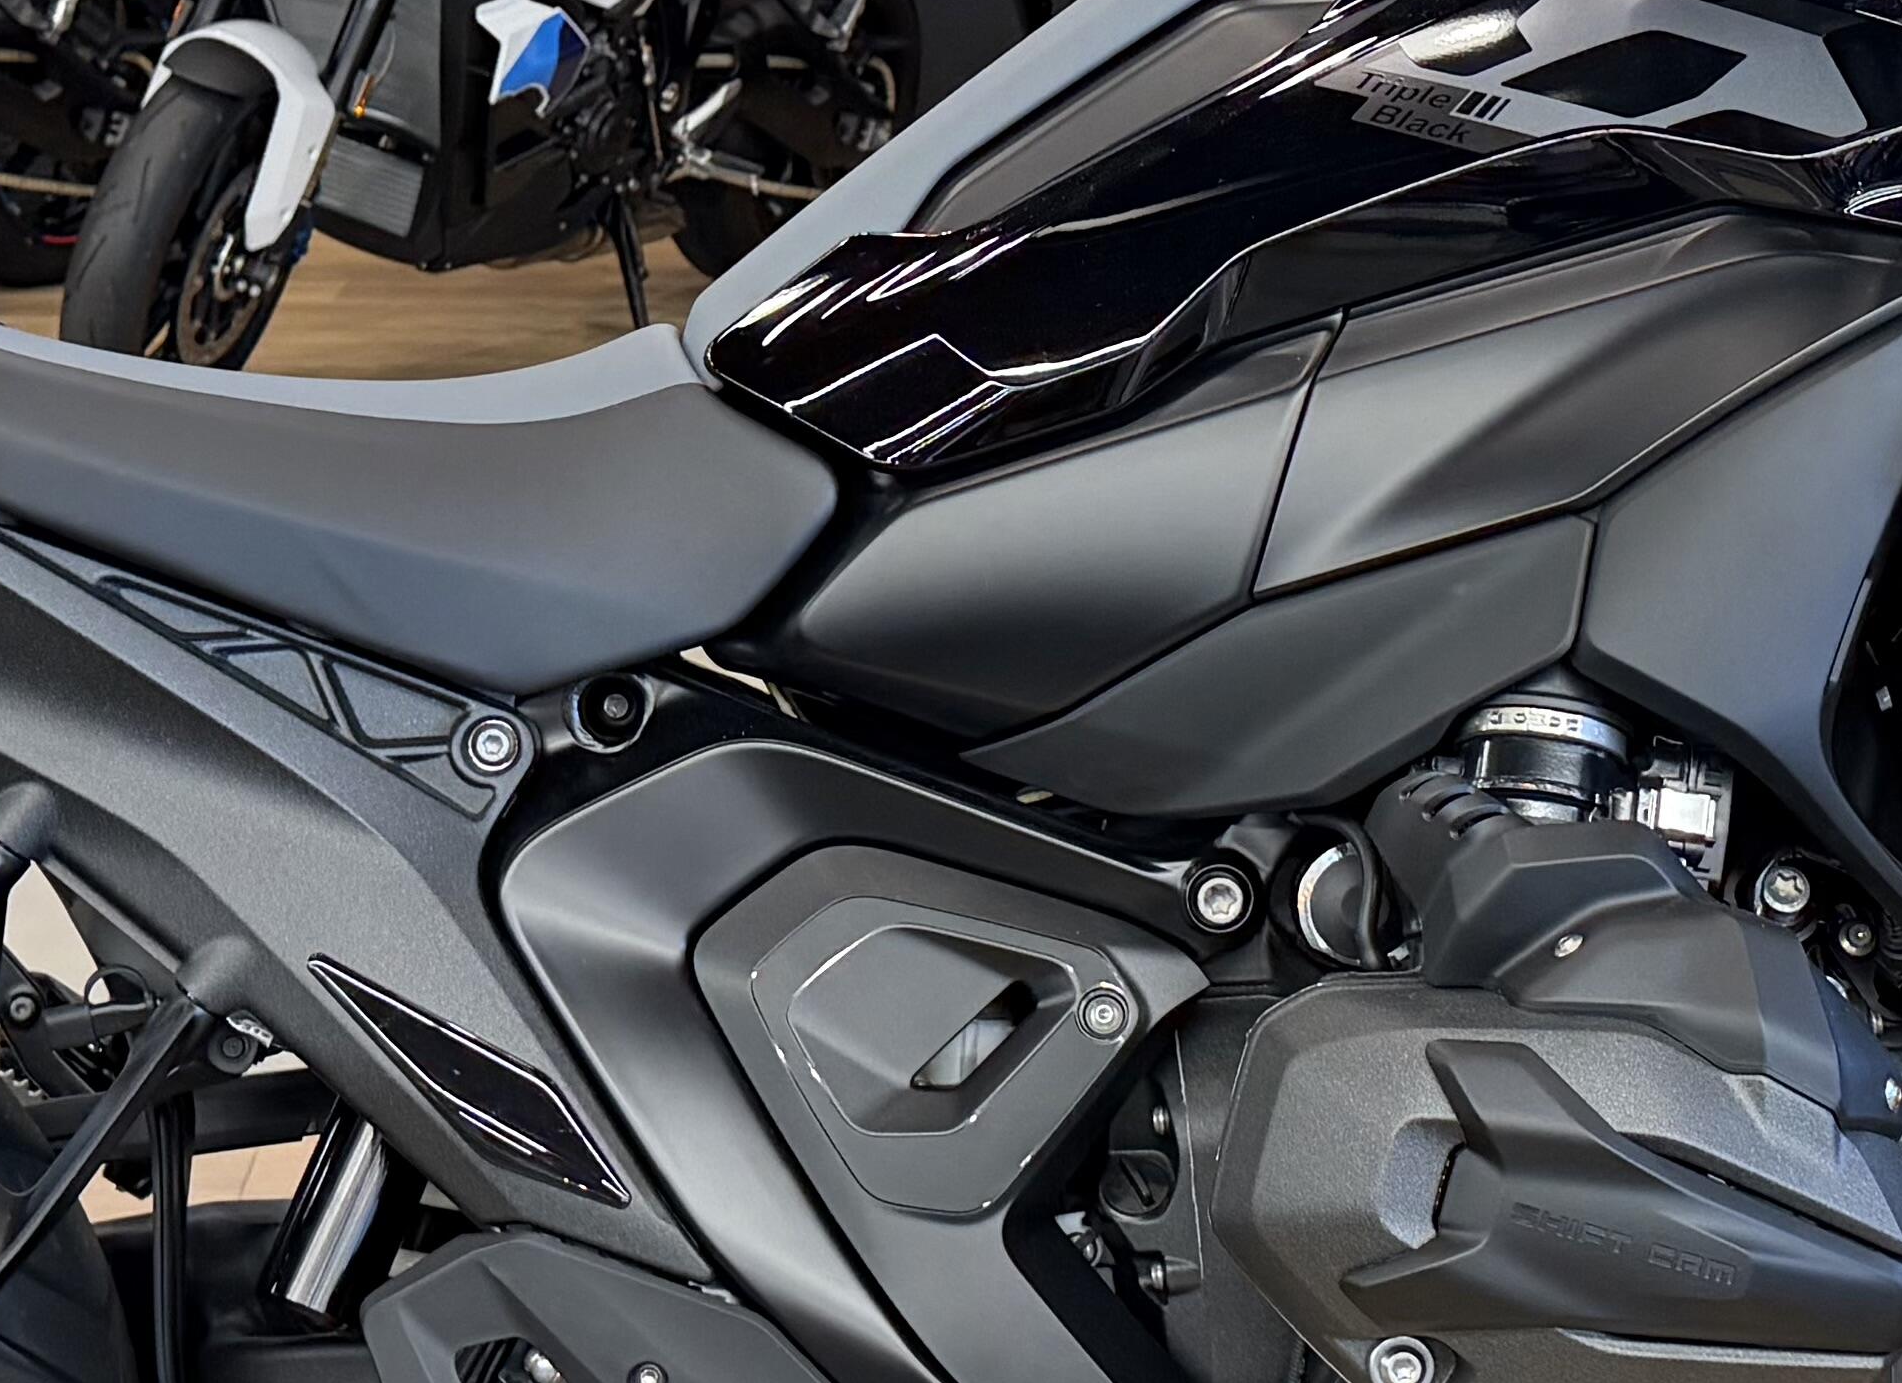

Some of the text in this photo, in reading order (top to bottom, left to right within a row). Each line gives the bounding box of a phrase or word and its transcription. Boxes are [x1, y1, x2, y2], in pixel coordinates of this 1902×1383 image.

[1356, 71, 1452, 108] Triple
[1369, 104, 1471, 144] Black
[1509, 1201, 1738, 1286] SHIFT CAM
